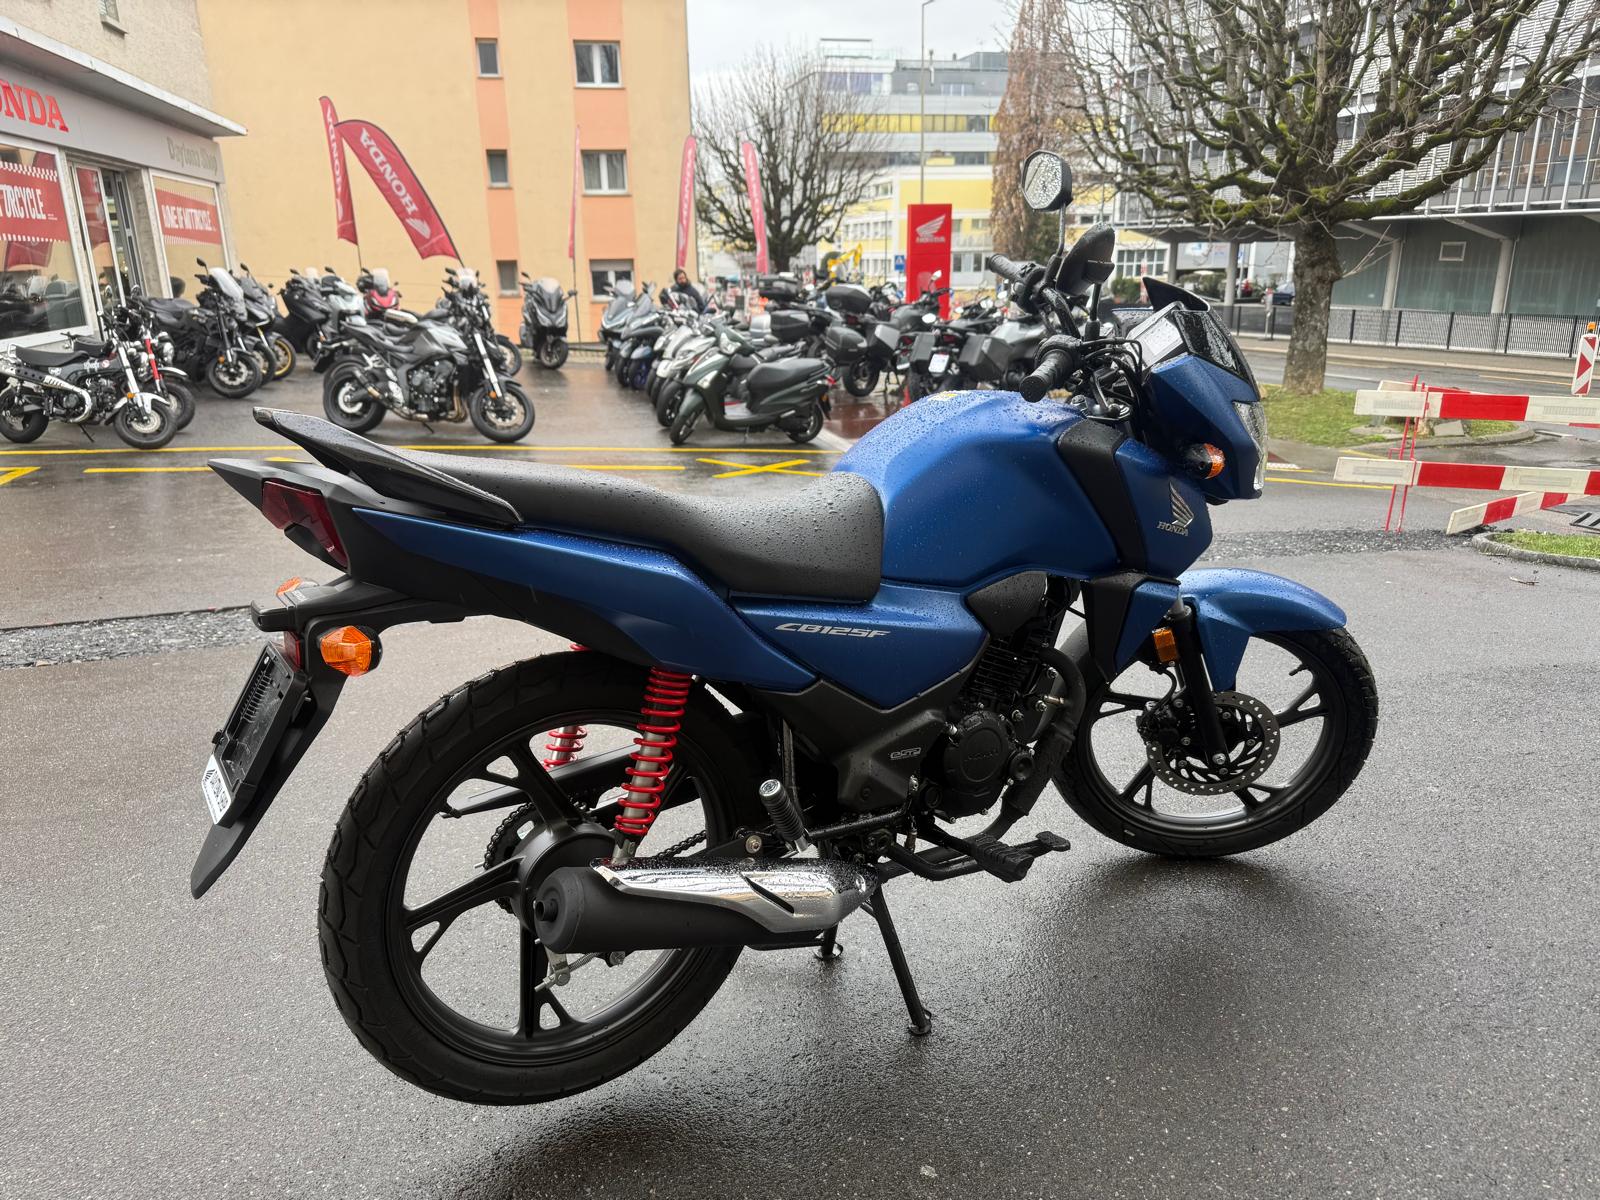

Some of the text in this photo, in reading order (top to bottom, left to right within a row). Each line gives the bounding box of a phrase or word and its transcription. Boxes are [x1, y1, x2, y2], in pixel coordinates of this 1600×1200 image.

[360, 127, 419, 215] HONDA
[1157, 521, 1188, 536] HONDA
[775, 622, 891, 638] CB125F
